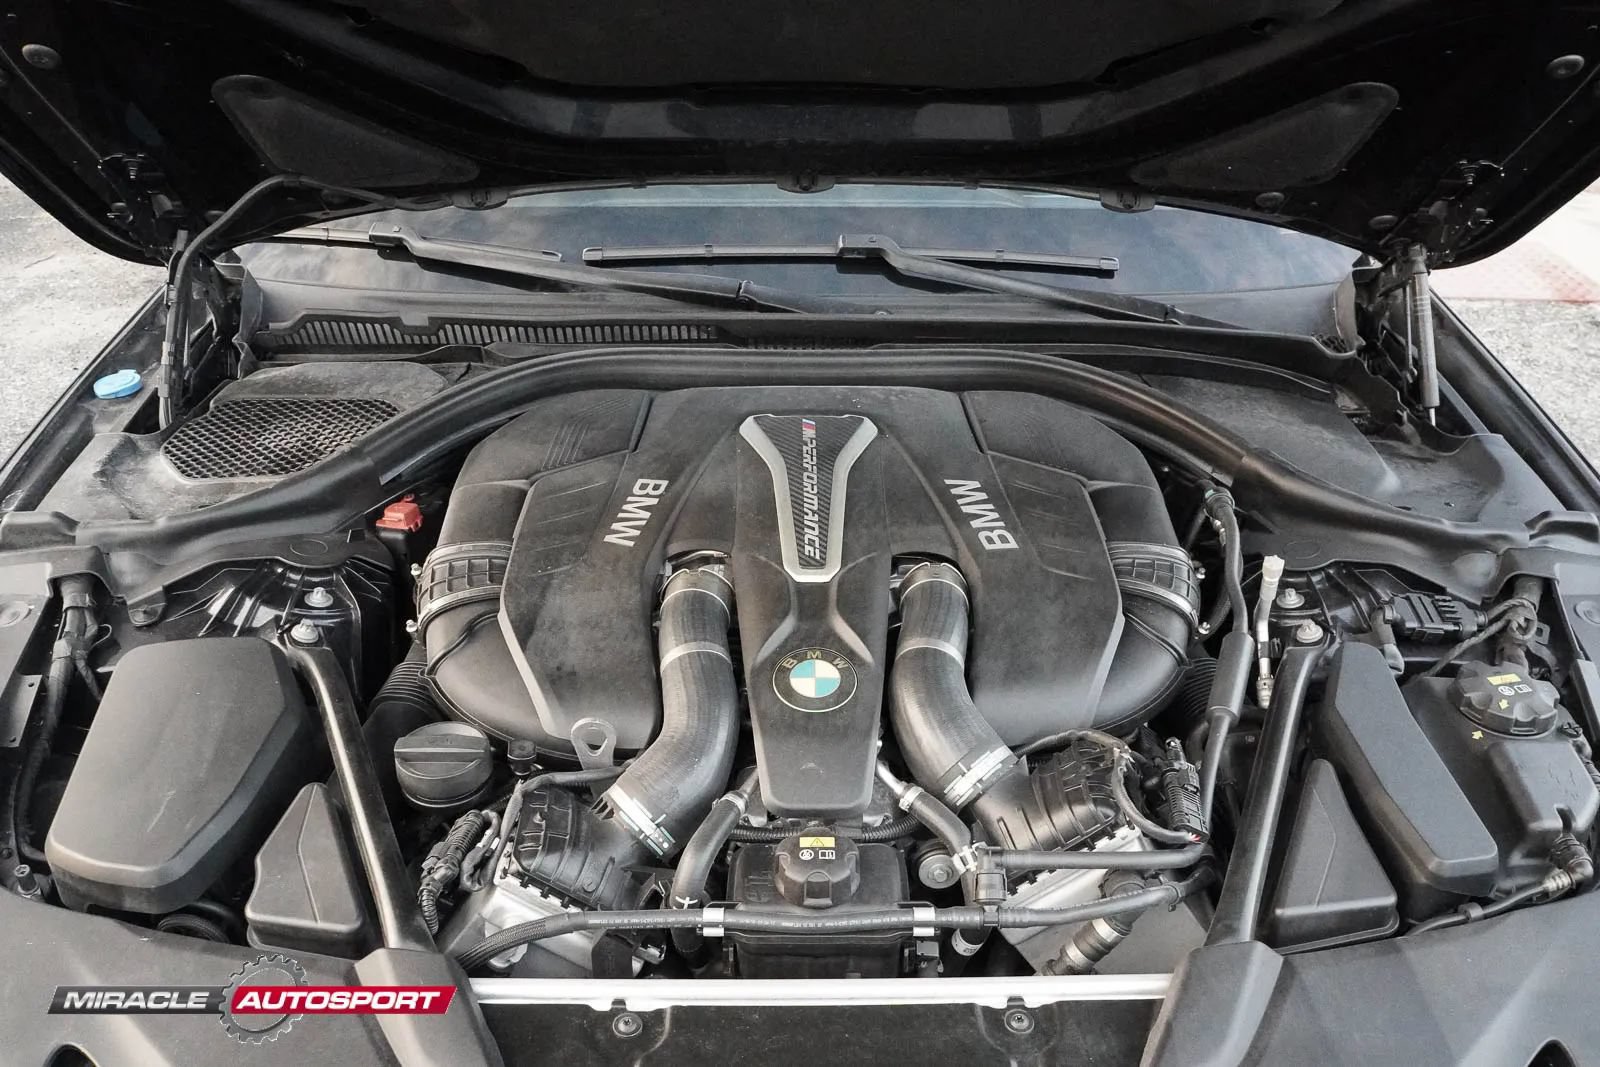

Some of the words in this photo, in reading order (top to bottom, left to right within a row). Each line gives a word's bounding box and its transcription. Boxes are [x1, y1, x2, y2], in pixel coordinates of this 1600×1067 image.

[603, 478, 670, 547] BMW
[803, 439, 820, 560] PERFORMANCE
[943, 479, 1020, 550] BMW
[782, 650, 849, 669] BMW
